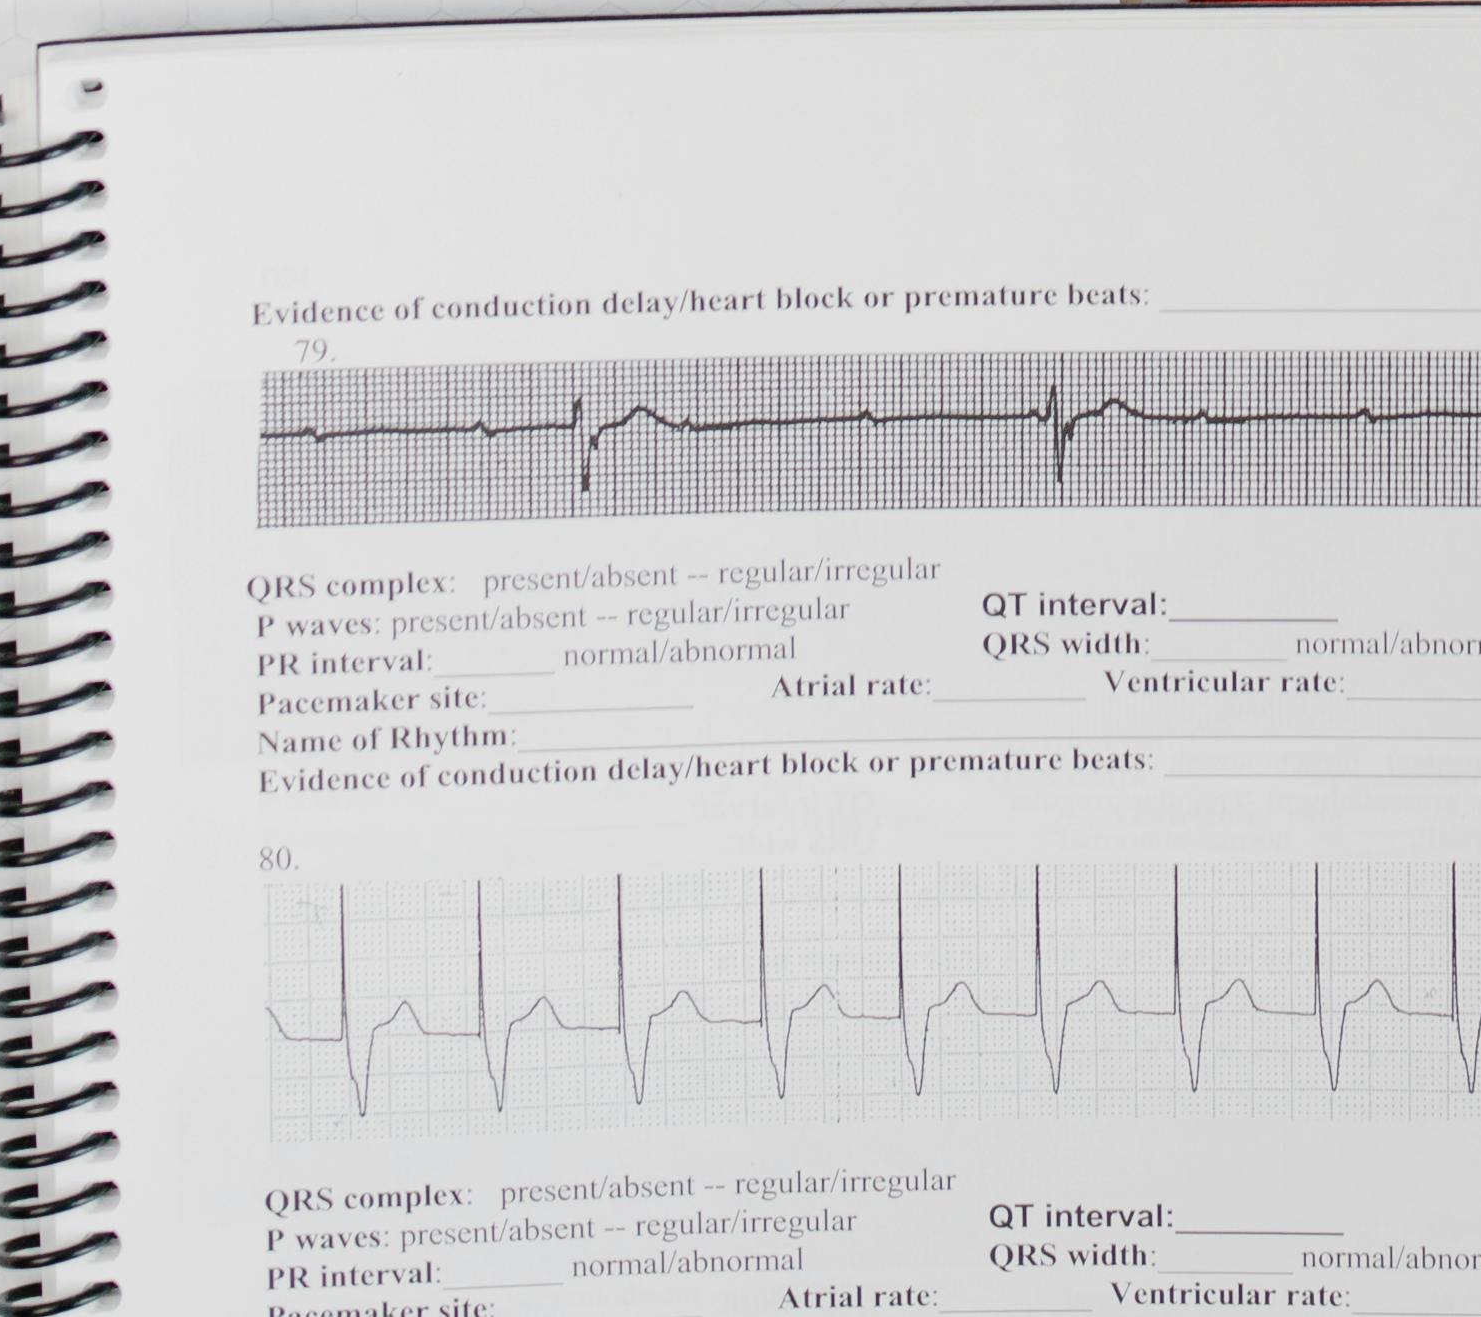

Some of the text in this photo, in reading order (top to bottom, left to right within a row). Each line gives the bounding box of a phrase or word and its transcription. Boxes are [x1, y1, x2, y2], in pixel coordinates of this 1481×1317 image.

[251, 281, 1150, 328] Evidence of conduction delay/heart block or premature beats:
[294, 337, 336, 364] 79.
[246, 570, 456, 607] QRS complex:
[483, 561, 679, 600] present/absent
[718, 555, 942, 591] regular/irregular
[255, 614, 276, 640] P
[285, 616, 381, 638] waves:
[390, 604, 588, 642] present/absent
[627, 595, 851, 633] regular/irregular
[981, 590, 1175, 624] QT interval:
[256, 647, 439, 679] PR interval:
[563, 634, 798, 667] normal/abnormal
[982, 630, 1157, 663] QRS width:
[256, 684, 494, 717] Pacemaker site:
[770, 672, 938, 703] Atrial rate:
[1102, 668, 1352, 702] Ventricular rate:
[257, 722, 523, 756] Name of Rhythm:
[258, 746, 1154, 794] Evidence of conduction delay/heart block or premature beats:
[259, 845, 300, 872] 80.
[264, 1182, 473, 1220] QRS complex:
[988, 1202, 1174, 1232] QT interval:
[265, 1227, 285, 1253] P
[294, 1230, 390, 1251] waves:
[399, 1216, 596, 1254] present/absent
[635, 1207, 858, 1244] regular/irregular
[571, 1246, 804, 1278] normal/abnormal
[988, 1242, 1157, 1274] QRS width:
[266, 1260, 449, 1292] PR interval:
[777, 1284, 945, 1315] Atrial rate:
[1109, 1280, 1351, 1308] Ventricular rate:
